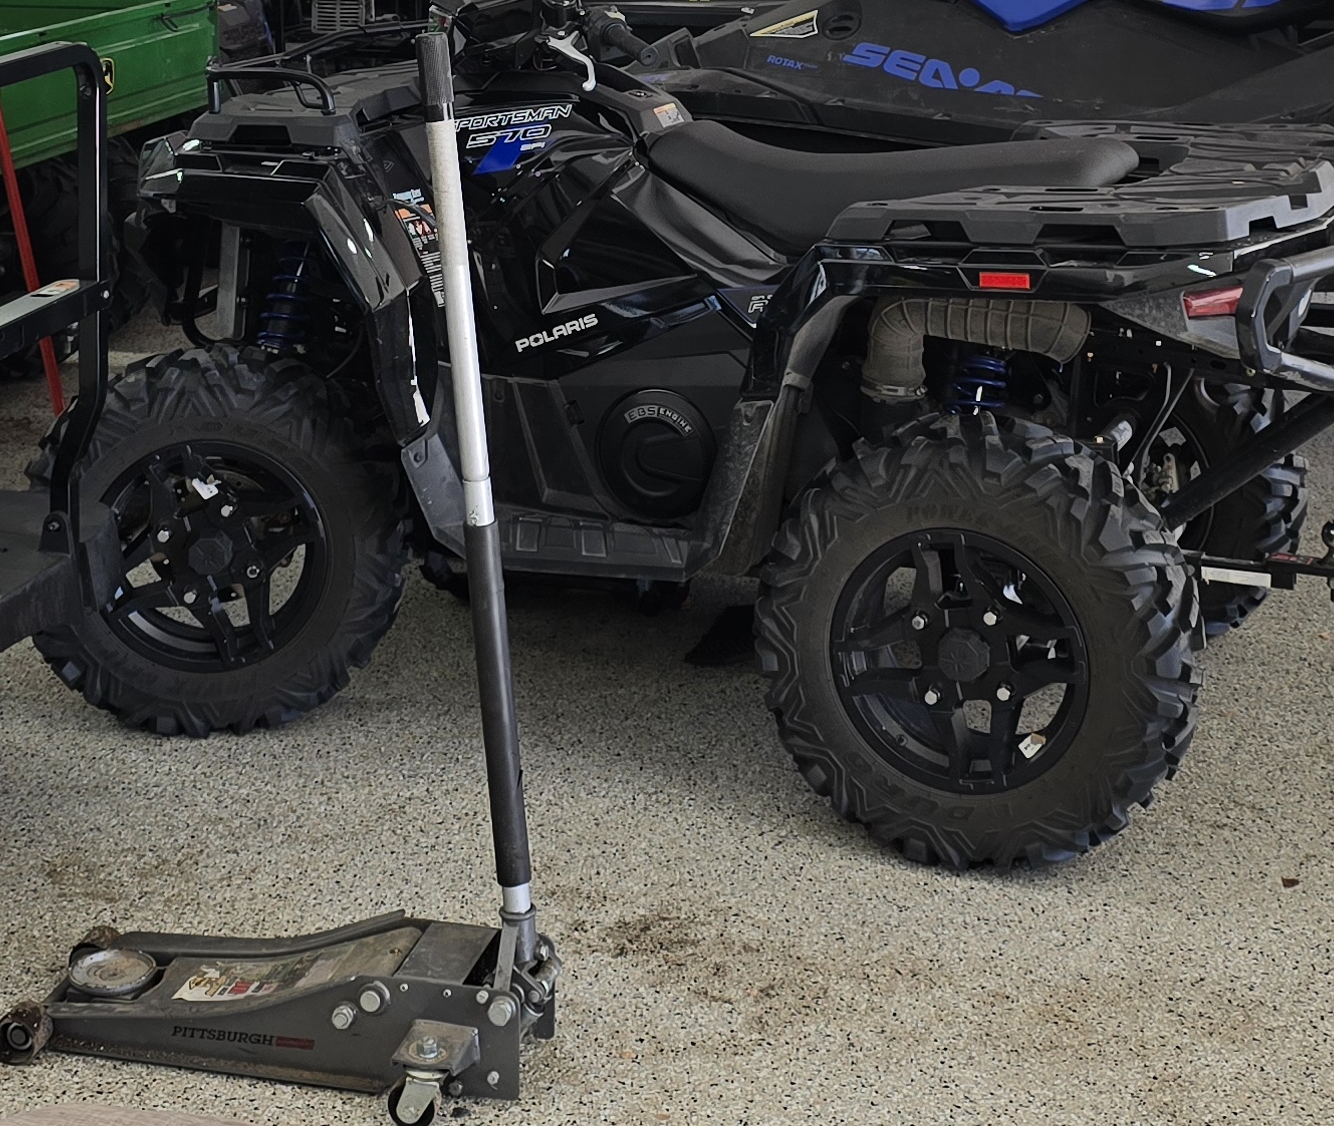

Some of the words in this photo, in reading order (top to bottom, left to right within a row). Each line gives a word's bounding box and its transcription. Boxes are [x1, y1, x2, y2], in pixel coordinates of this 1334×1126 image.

[767, 54, 803, 70] ROTAX
[466, 124, 552, 149] 570
[515, 313, 599, 353] POLARIS
[627, 406, 657, 424] EBS
[658, 407, 693, 434] ENGINE
[171, 1025, 275, 1046] PITTSBURGH
